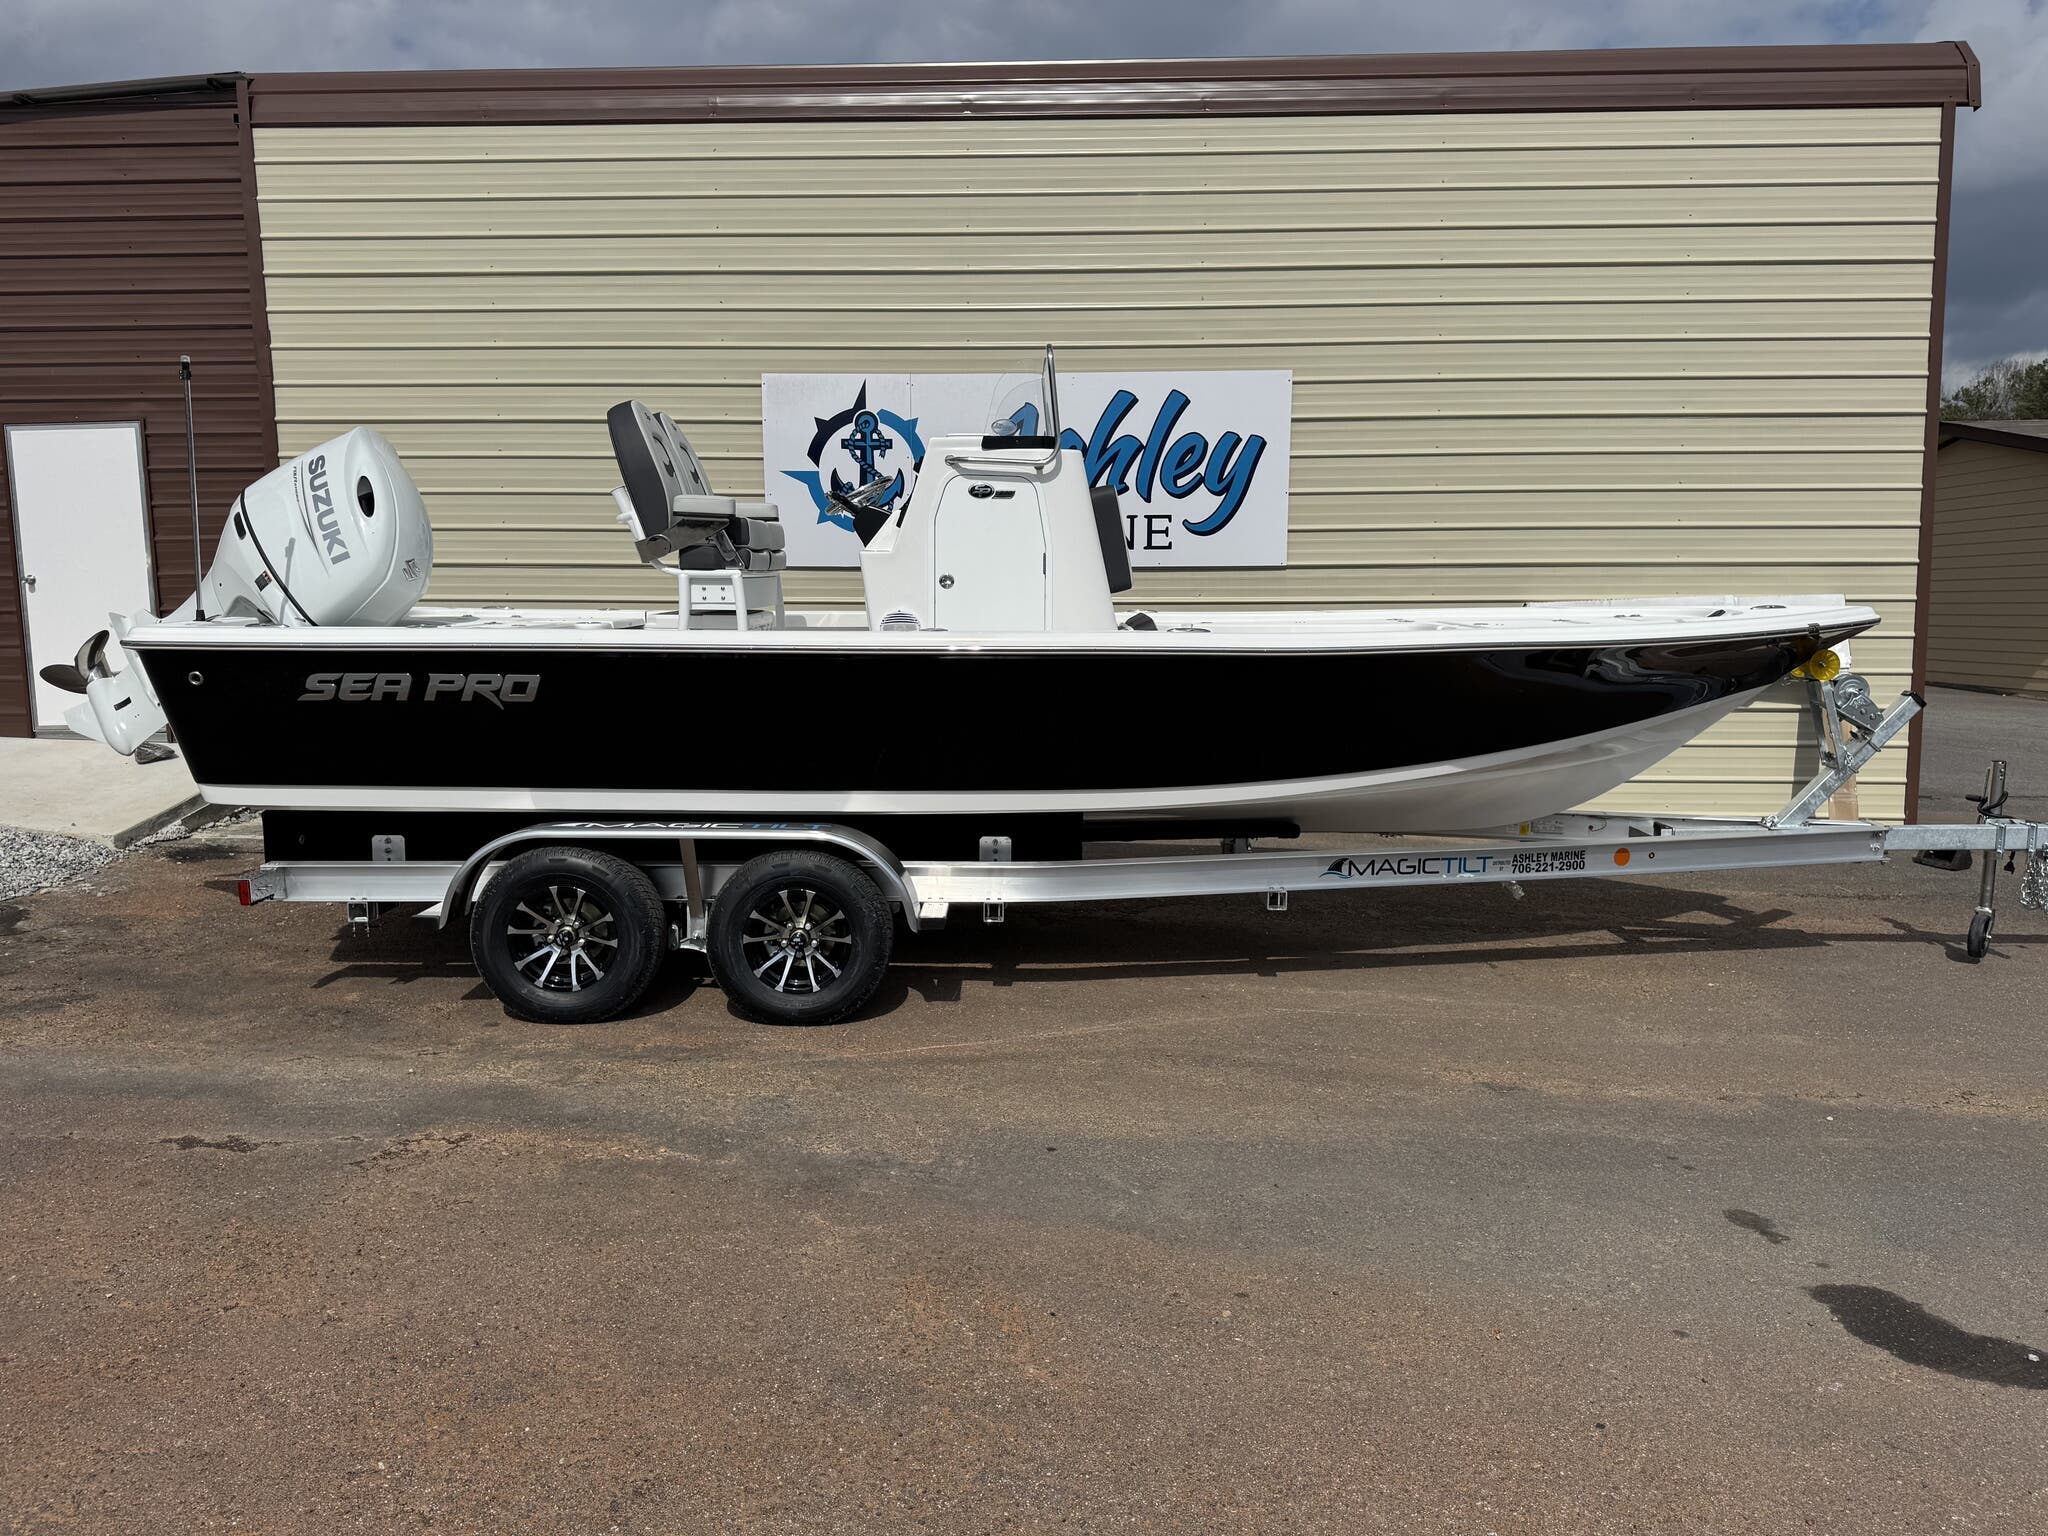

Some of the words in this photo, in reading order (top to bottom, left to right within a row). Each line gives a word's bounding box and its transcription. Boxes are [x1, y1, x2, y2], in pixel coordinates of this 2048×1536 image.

[308, 454, 351, 565] SUZUKI
[297, 672, 412, 701] SEA
[424, 672, 541, 710] PRO
[1348, 855, 1494, 877] MAGICTILT
[1511, 859, 1587, 874] 706-221-2900
[1512, 852, 1549, 864] ASHLEY
[1550, 850, 1587, 862] MARINE
